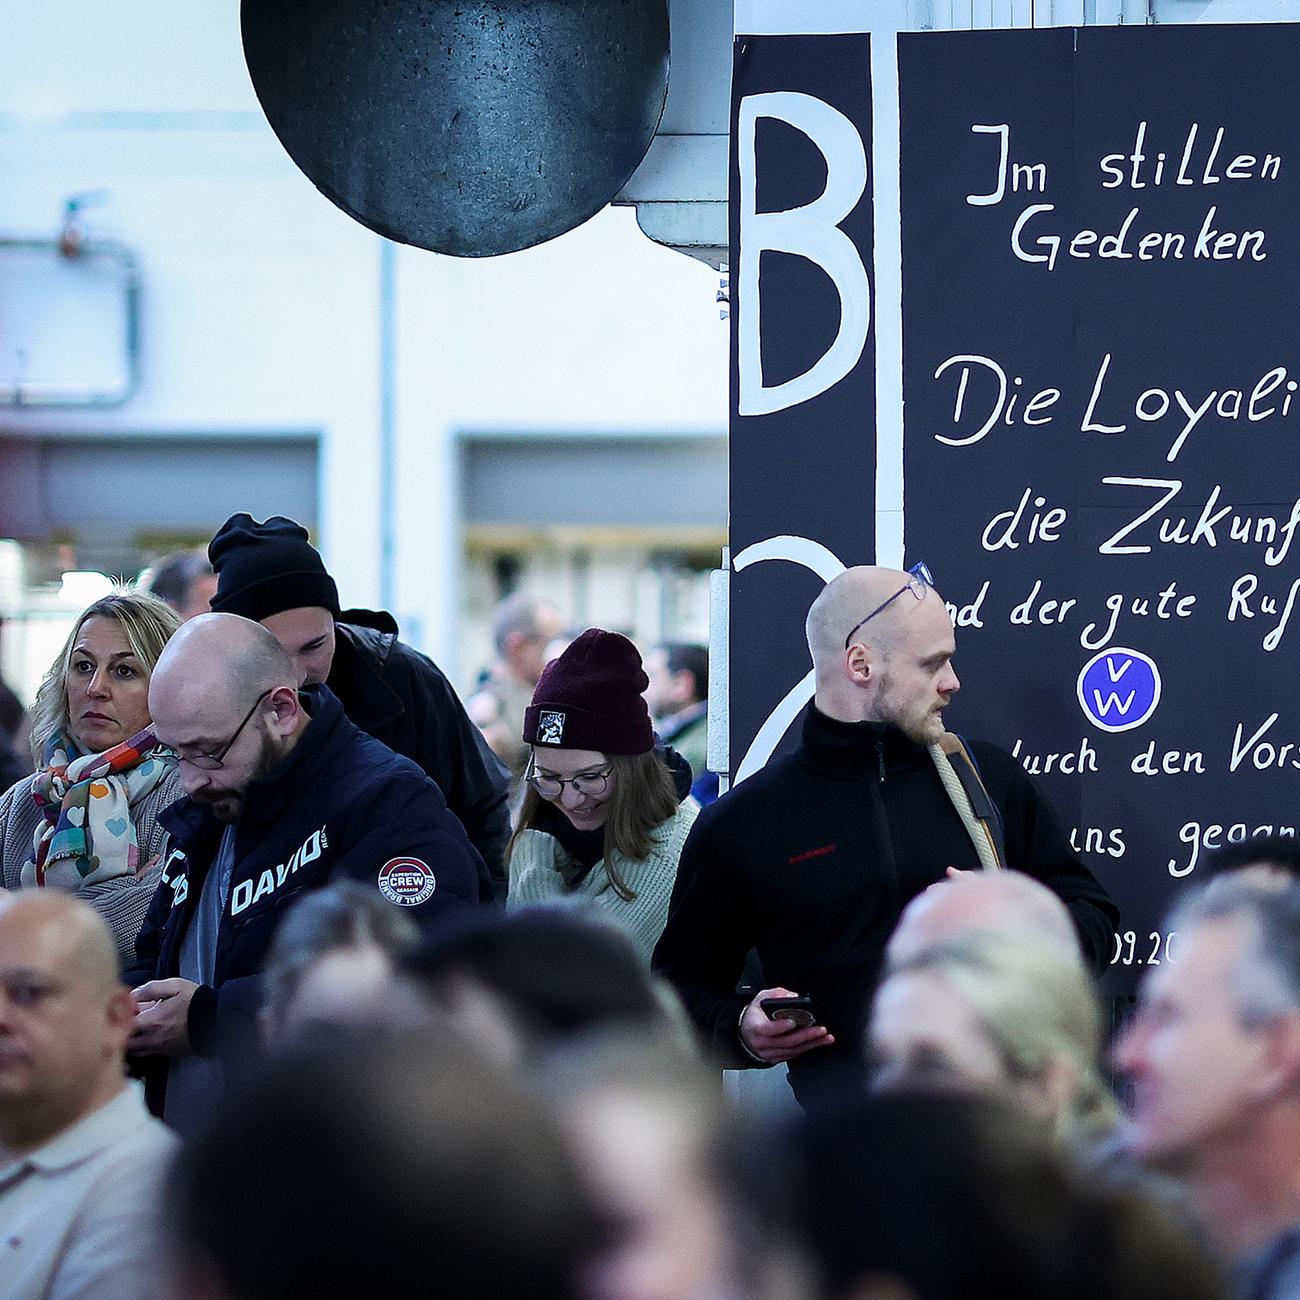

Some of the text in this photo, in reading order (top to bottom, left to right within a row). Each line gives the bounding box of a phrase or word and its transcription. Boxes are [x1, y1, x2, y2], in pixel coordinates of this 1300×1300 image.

[1100, 121, 1281, 189] stillen
[739, 91, 871, 417] B
[1011, 204, 1267, 271] Gedenken
[934, 354, 1061, 446] Die
[981, 487, 1067, 552] die
[945, 580, 991, 629] nd
[1010, 579, 1077, 625] der
[1080, 589, 1197, 650] gute
[1130, 740, 1206, 776] den
[231, 830, 321, 916] DAVID
[390, 876, 423, 887] CREW
